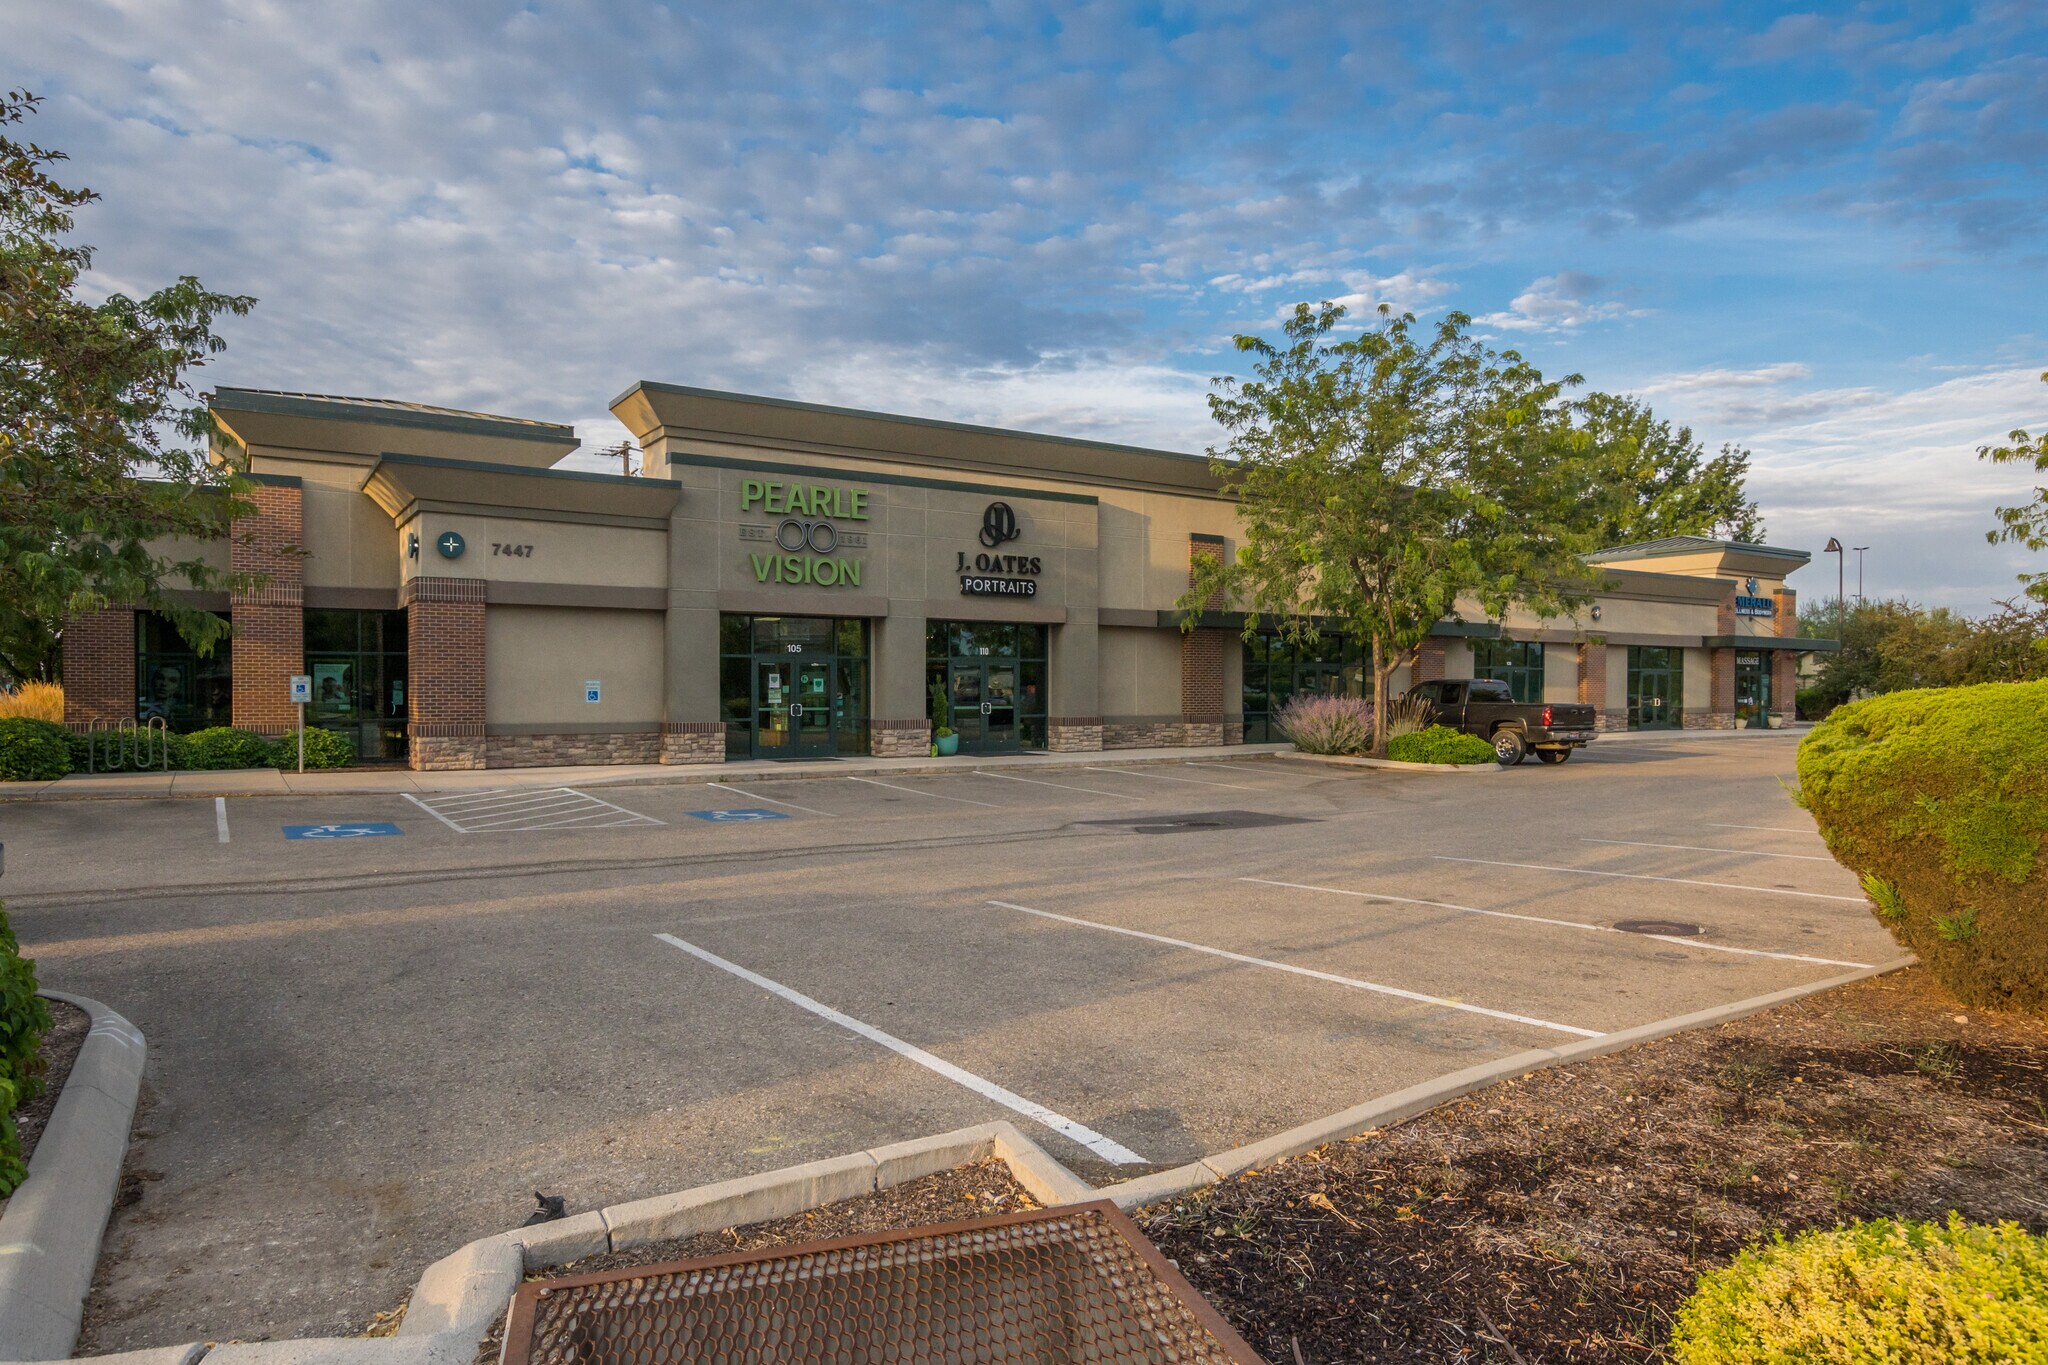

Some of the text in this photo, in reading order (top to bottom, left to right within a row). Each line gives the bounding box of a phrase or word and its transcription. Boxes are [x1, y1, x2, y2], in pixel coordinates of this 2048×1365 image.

[742, 479, 869, 520] PEARLE
[492, 543, 534, 558] 7447
[750, 552, 861, 586] VISION
[956, 552, 1042, 575] J. OATES
[965, 578, 1035, 595] PORTRAITS
[787, 644, 802, 653] 105
[980, 647, 989, 656] 110
[1736, 656, 1759, 665] MASSAGE
